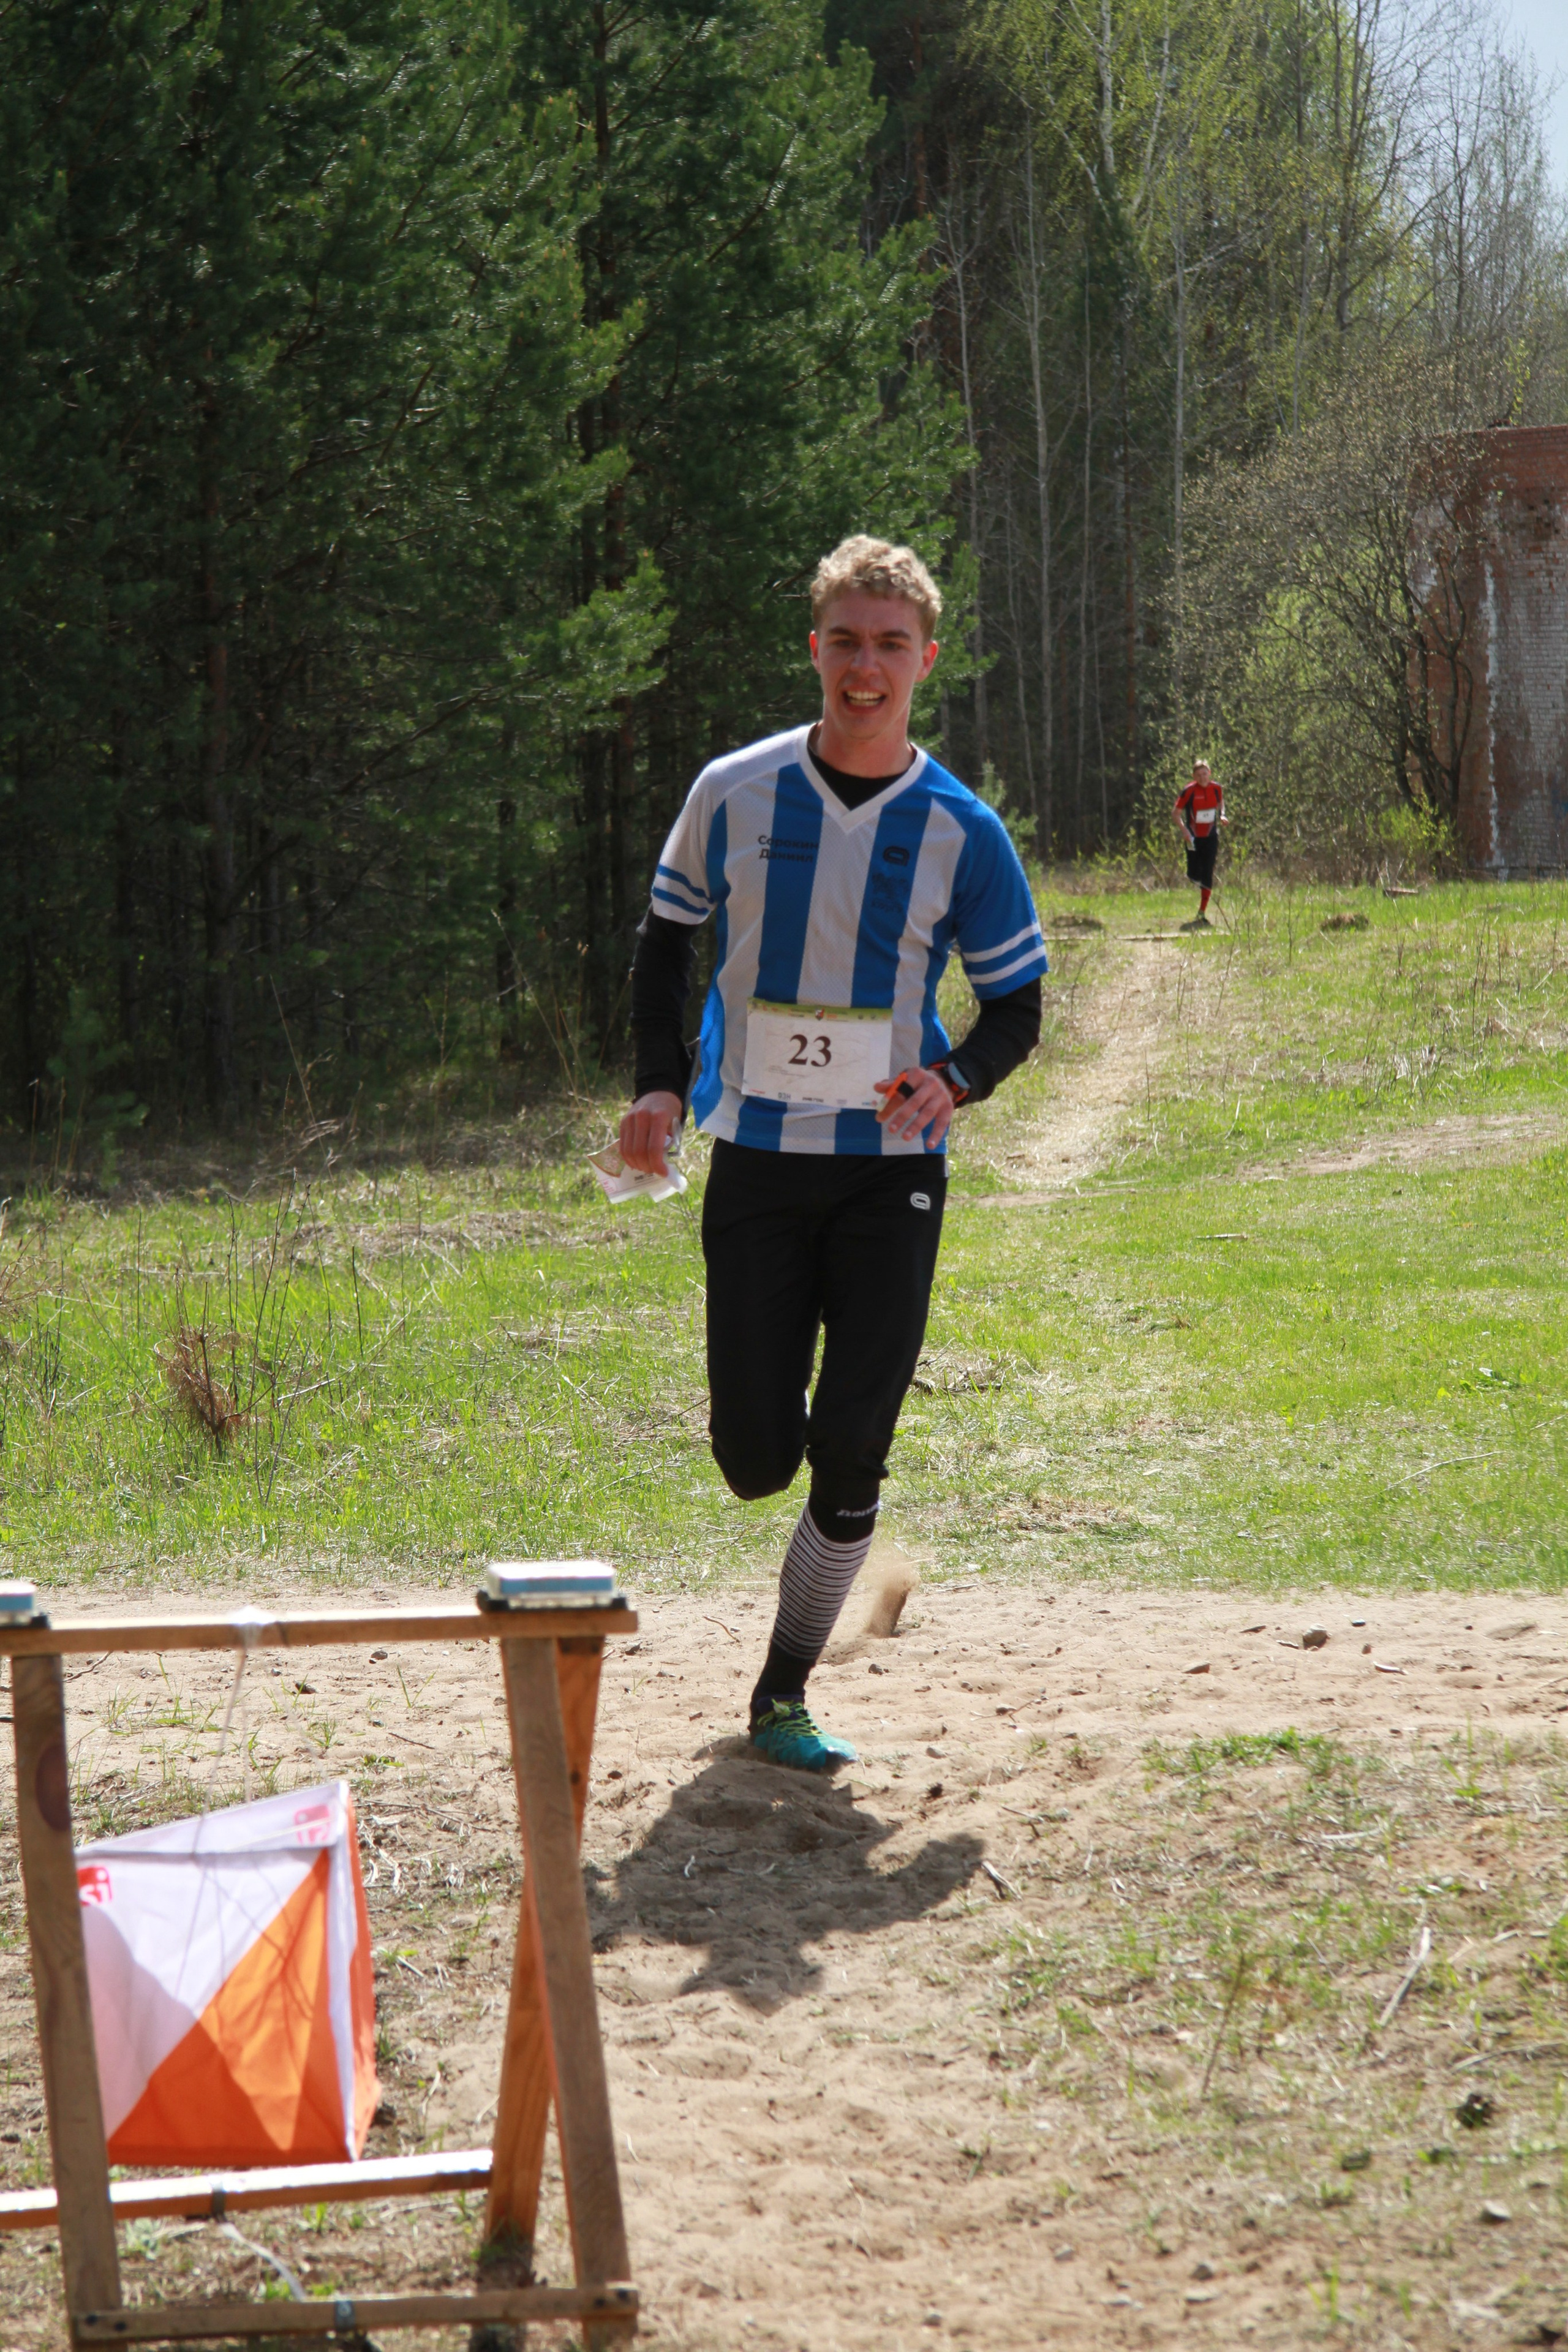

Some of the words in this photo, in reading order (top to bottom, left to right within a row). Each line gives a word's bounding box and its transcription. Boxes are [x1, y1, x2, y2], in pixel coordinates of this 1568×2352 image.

[758, 835, 819, 849] Сорокин
[759, 848, 813, 862] Даниил
[788, 1034, 832, 1067] 23
